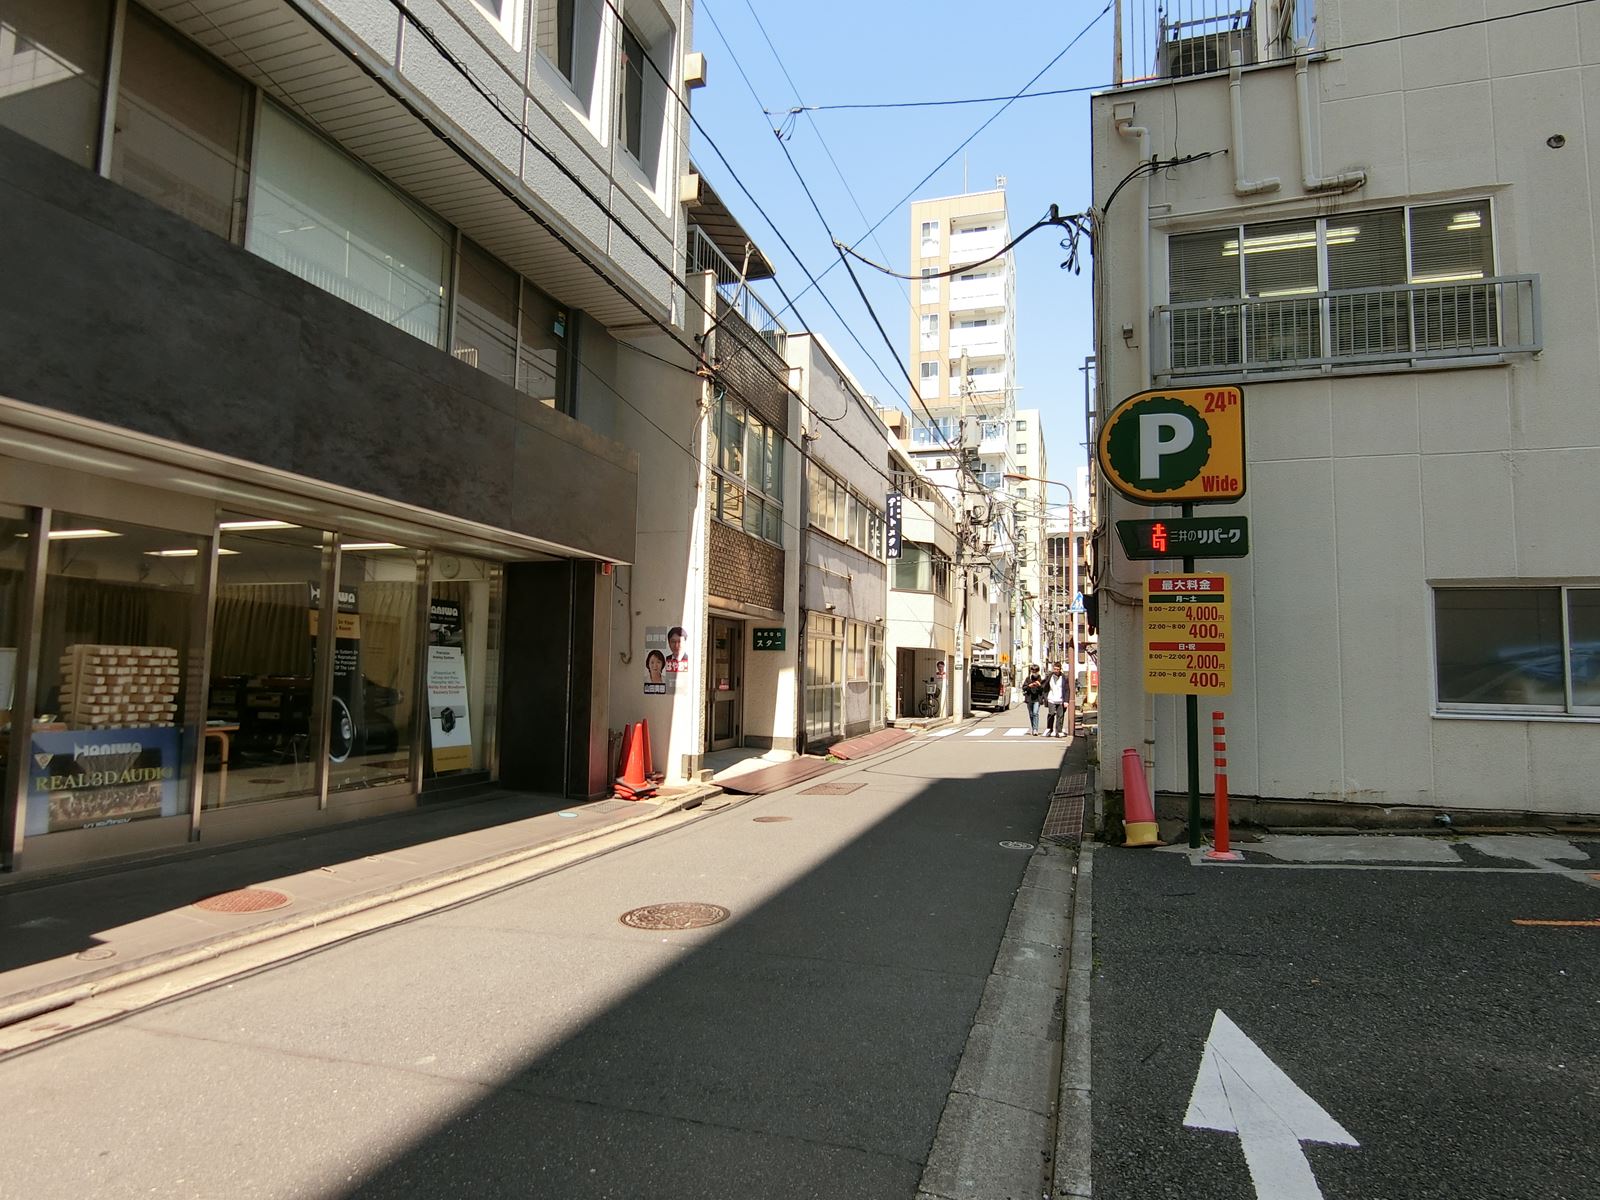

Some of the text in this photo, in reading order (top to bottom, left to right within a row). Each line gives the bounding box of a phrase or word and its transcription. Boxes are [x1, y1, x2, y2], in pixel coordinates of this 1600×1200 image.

[1204, 391, 1237, 413] 24h
[1139, 412, 1195, 481] P
[1201, 475, 1238, 492] Wide
[1170, 528, 1241, 544] 三井のリパーク
[1161, 579, 1211, 591] 最大料金
[756, 640, 782, 648] スター
[35, 767, 173, 791] REAL 3D AUDIO
